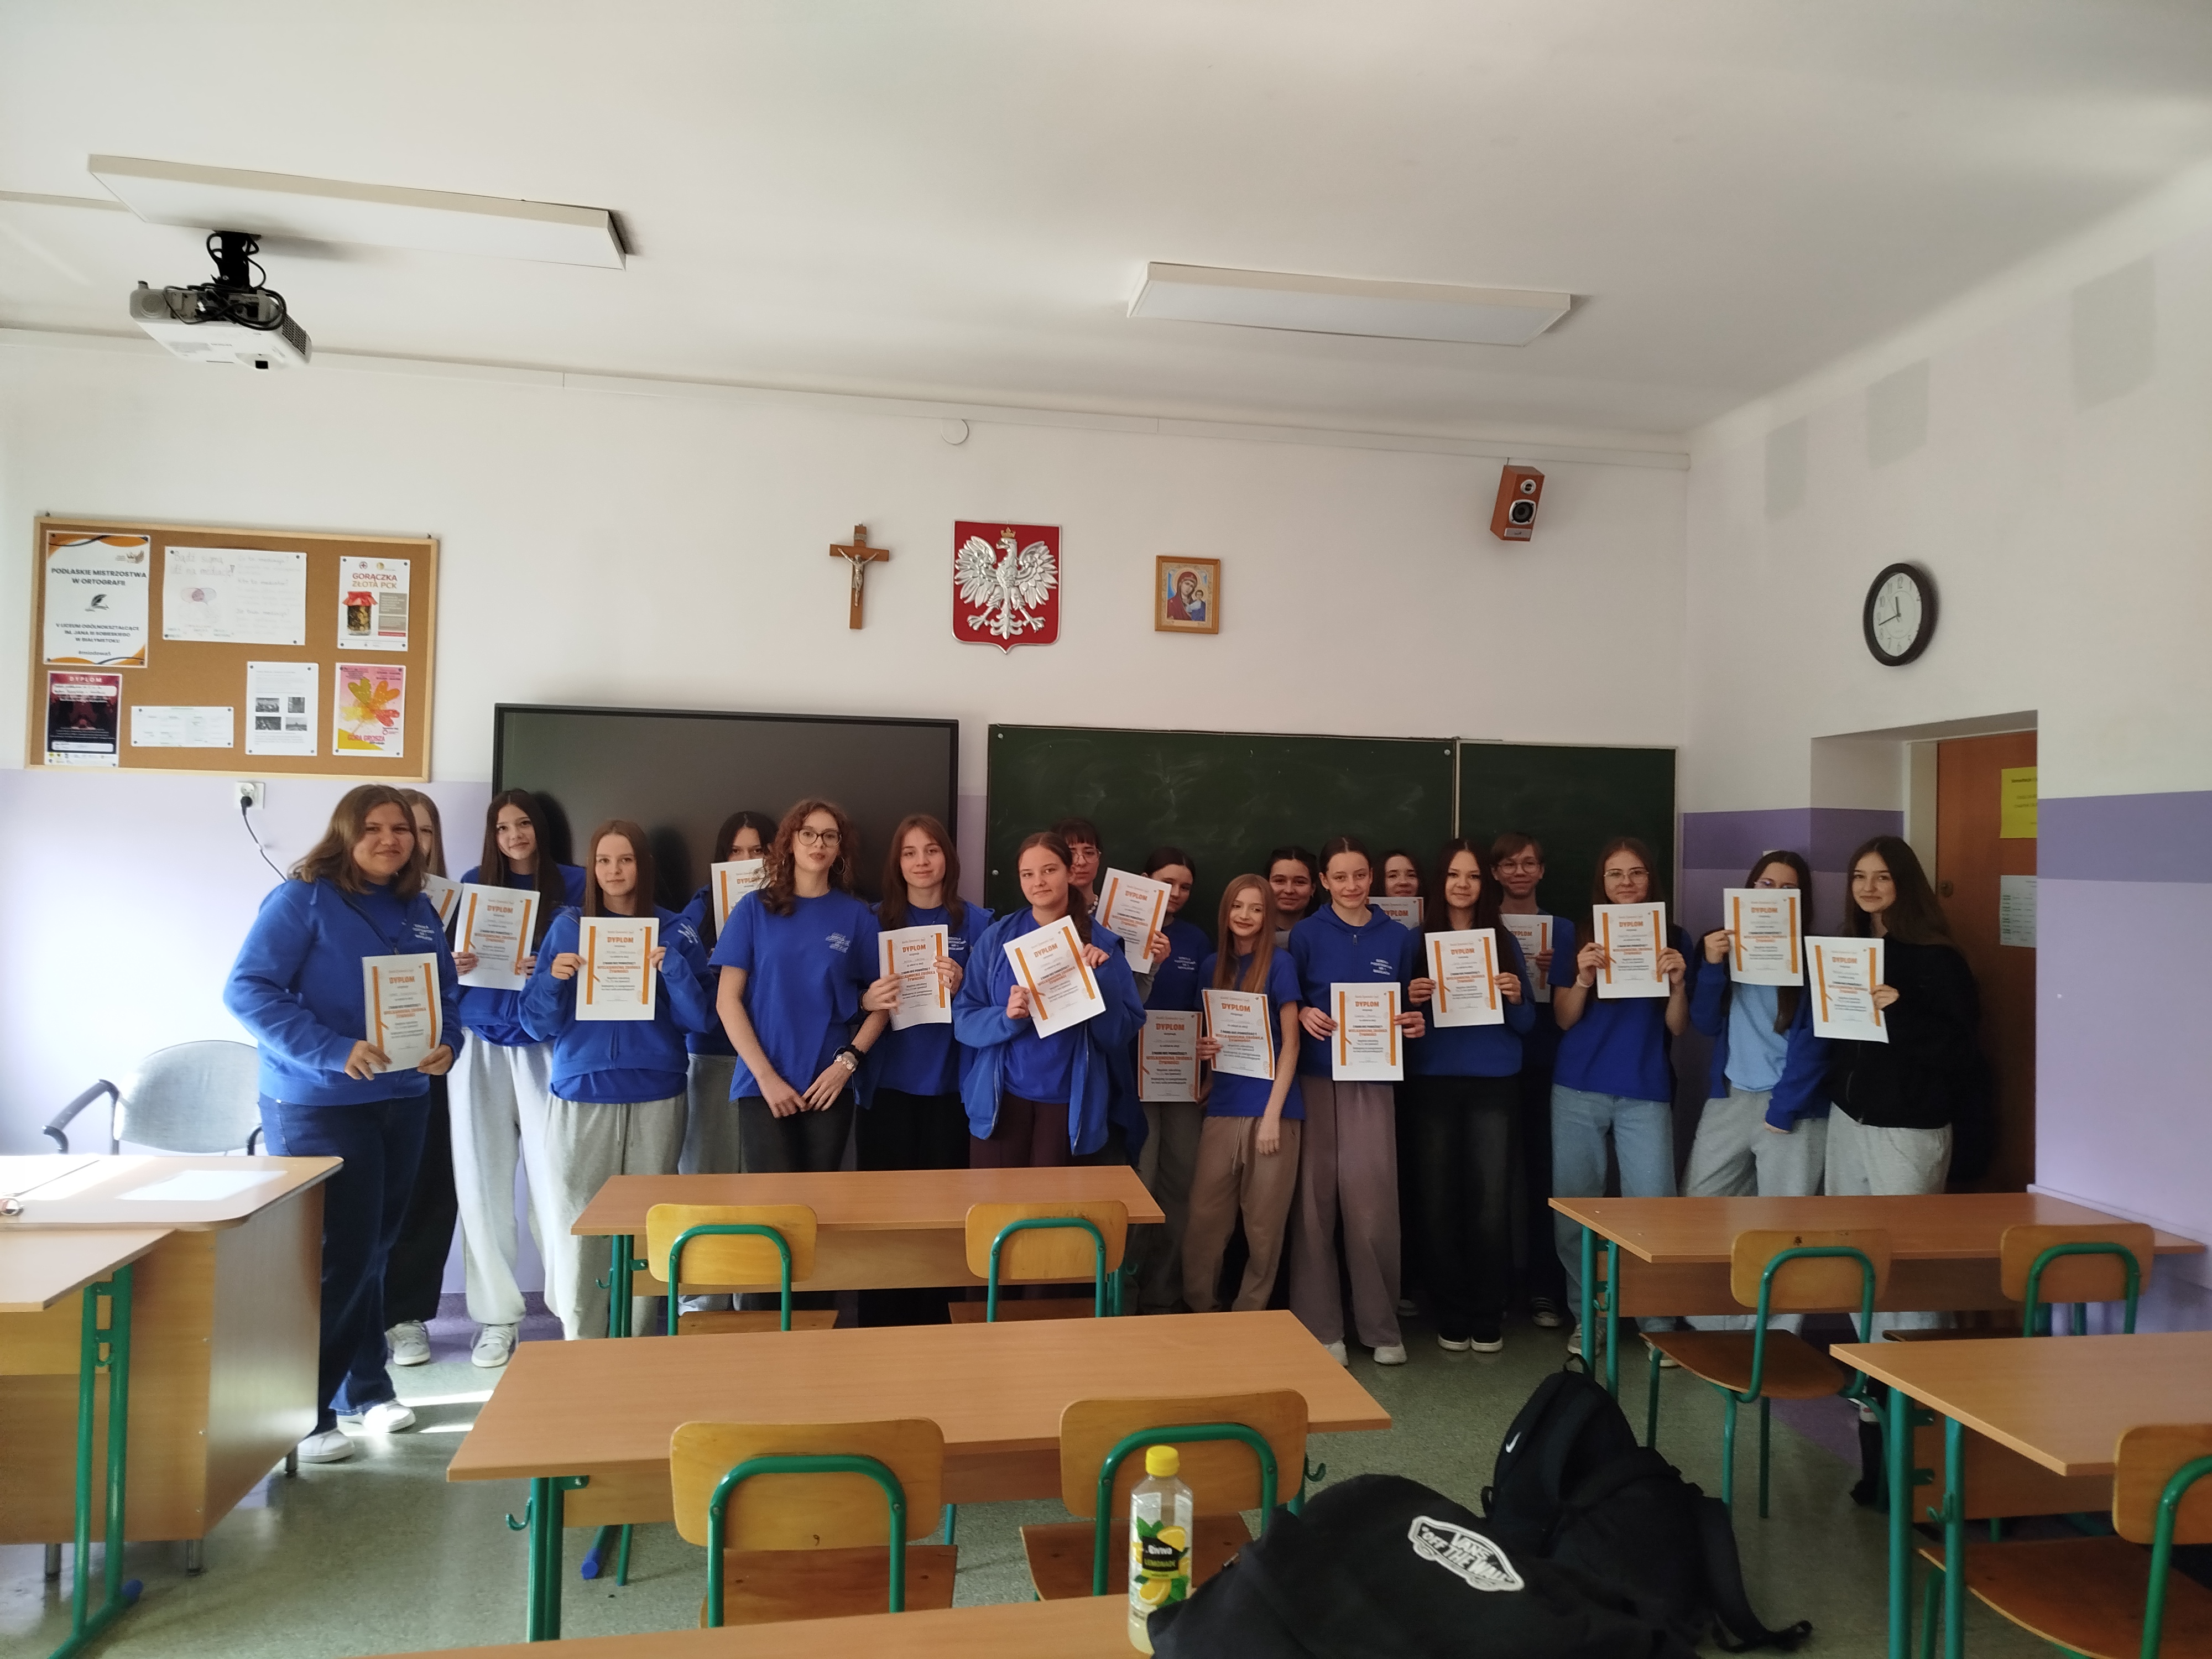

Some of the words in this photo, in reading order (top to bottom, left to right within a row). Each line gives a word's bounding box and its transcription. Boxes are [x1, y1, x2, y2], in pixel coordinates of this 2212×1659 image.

[93, 570, 147, 578] MISTRZOSTWA
[352, 573, 397, 582] GORĄCZKA
[82, 578, 126, 586] ORTOGRAFII
[82, 623, 139, 632] OGÓLNOKSZTAŁCĄCE
[1125, 890, 1147, 901] DYPLOM
[487, 905, 513, 914] DYPLOM
[902, 944, 926, 953] DYPLOM
[1034, 943, 1058, 958] DYPLOM
[389, 975, 415, 984] DYPLOM
[1222, 1003, 1251, 1012] DYPLOM
[1450, 1532, 1494, 1560] VANS
[1443, 1543, 1477, 1568] THE
